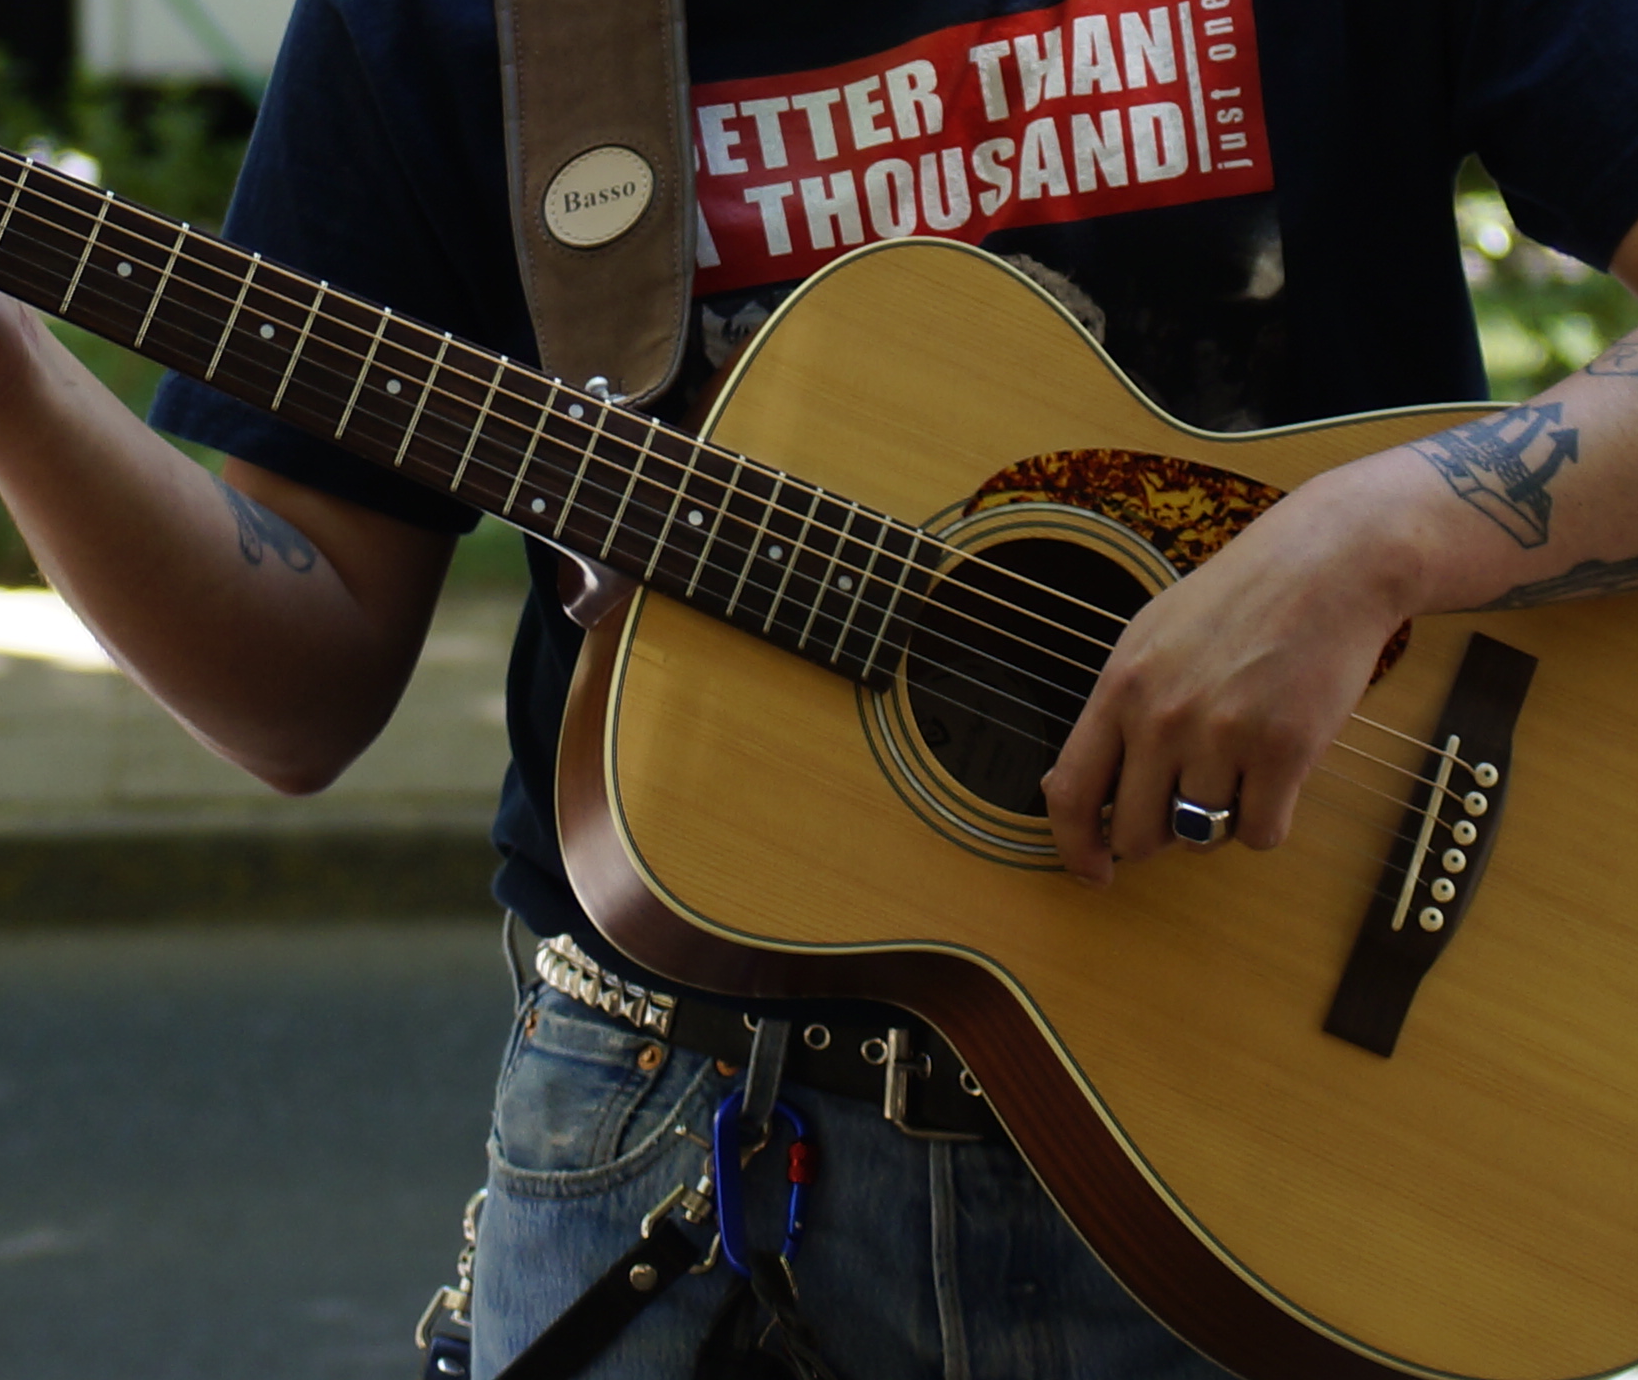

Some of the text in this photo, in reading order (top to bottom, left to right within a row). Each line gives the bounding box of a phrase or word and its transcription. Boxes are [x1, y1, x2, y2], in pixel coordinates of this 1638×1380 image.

[694, 5, 1178, 177] ETTER THAN
[1210, 86, 1254, 169] just
[563, 181, 636, 214] Basso
[744, 100, 1191, 257] THOUSAND
